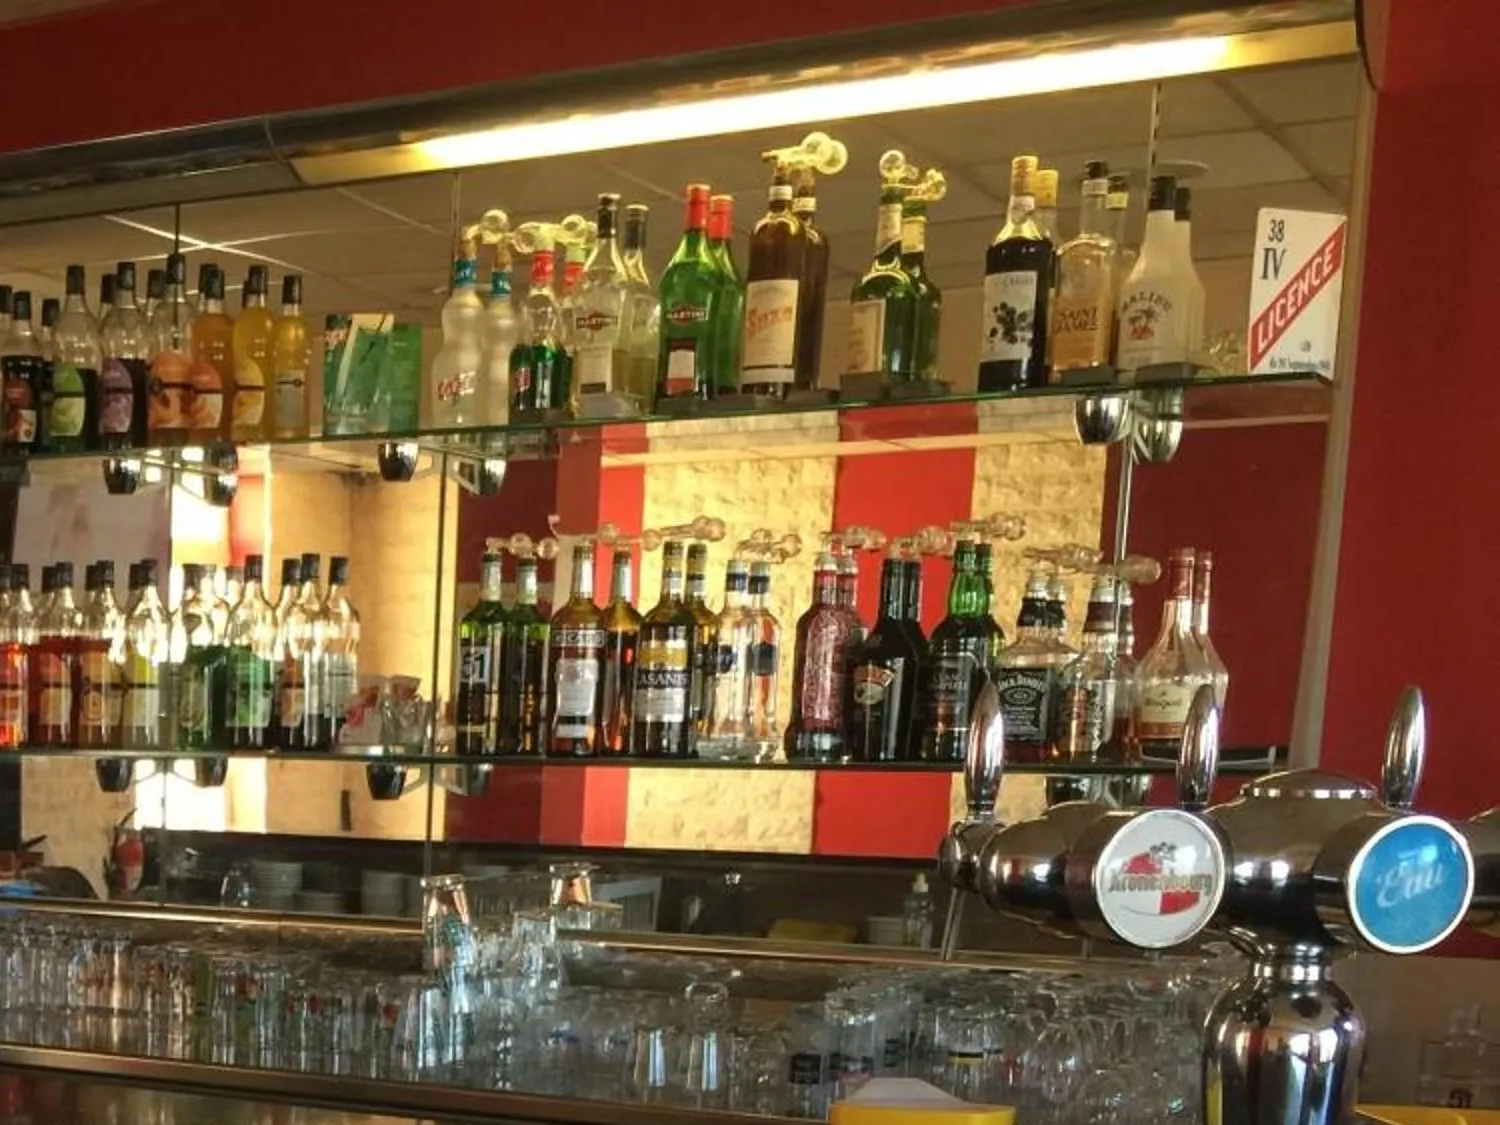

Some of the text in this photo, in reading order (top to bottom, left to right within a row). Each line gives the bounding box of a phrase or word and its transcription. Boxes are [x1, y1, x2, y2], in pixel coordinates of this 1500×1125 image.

[1267, 219, 1285, 243] 38
[1261, 247, 1287, 280] IV
[1256, 240, 1336, 355] LICENCE
